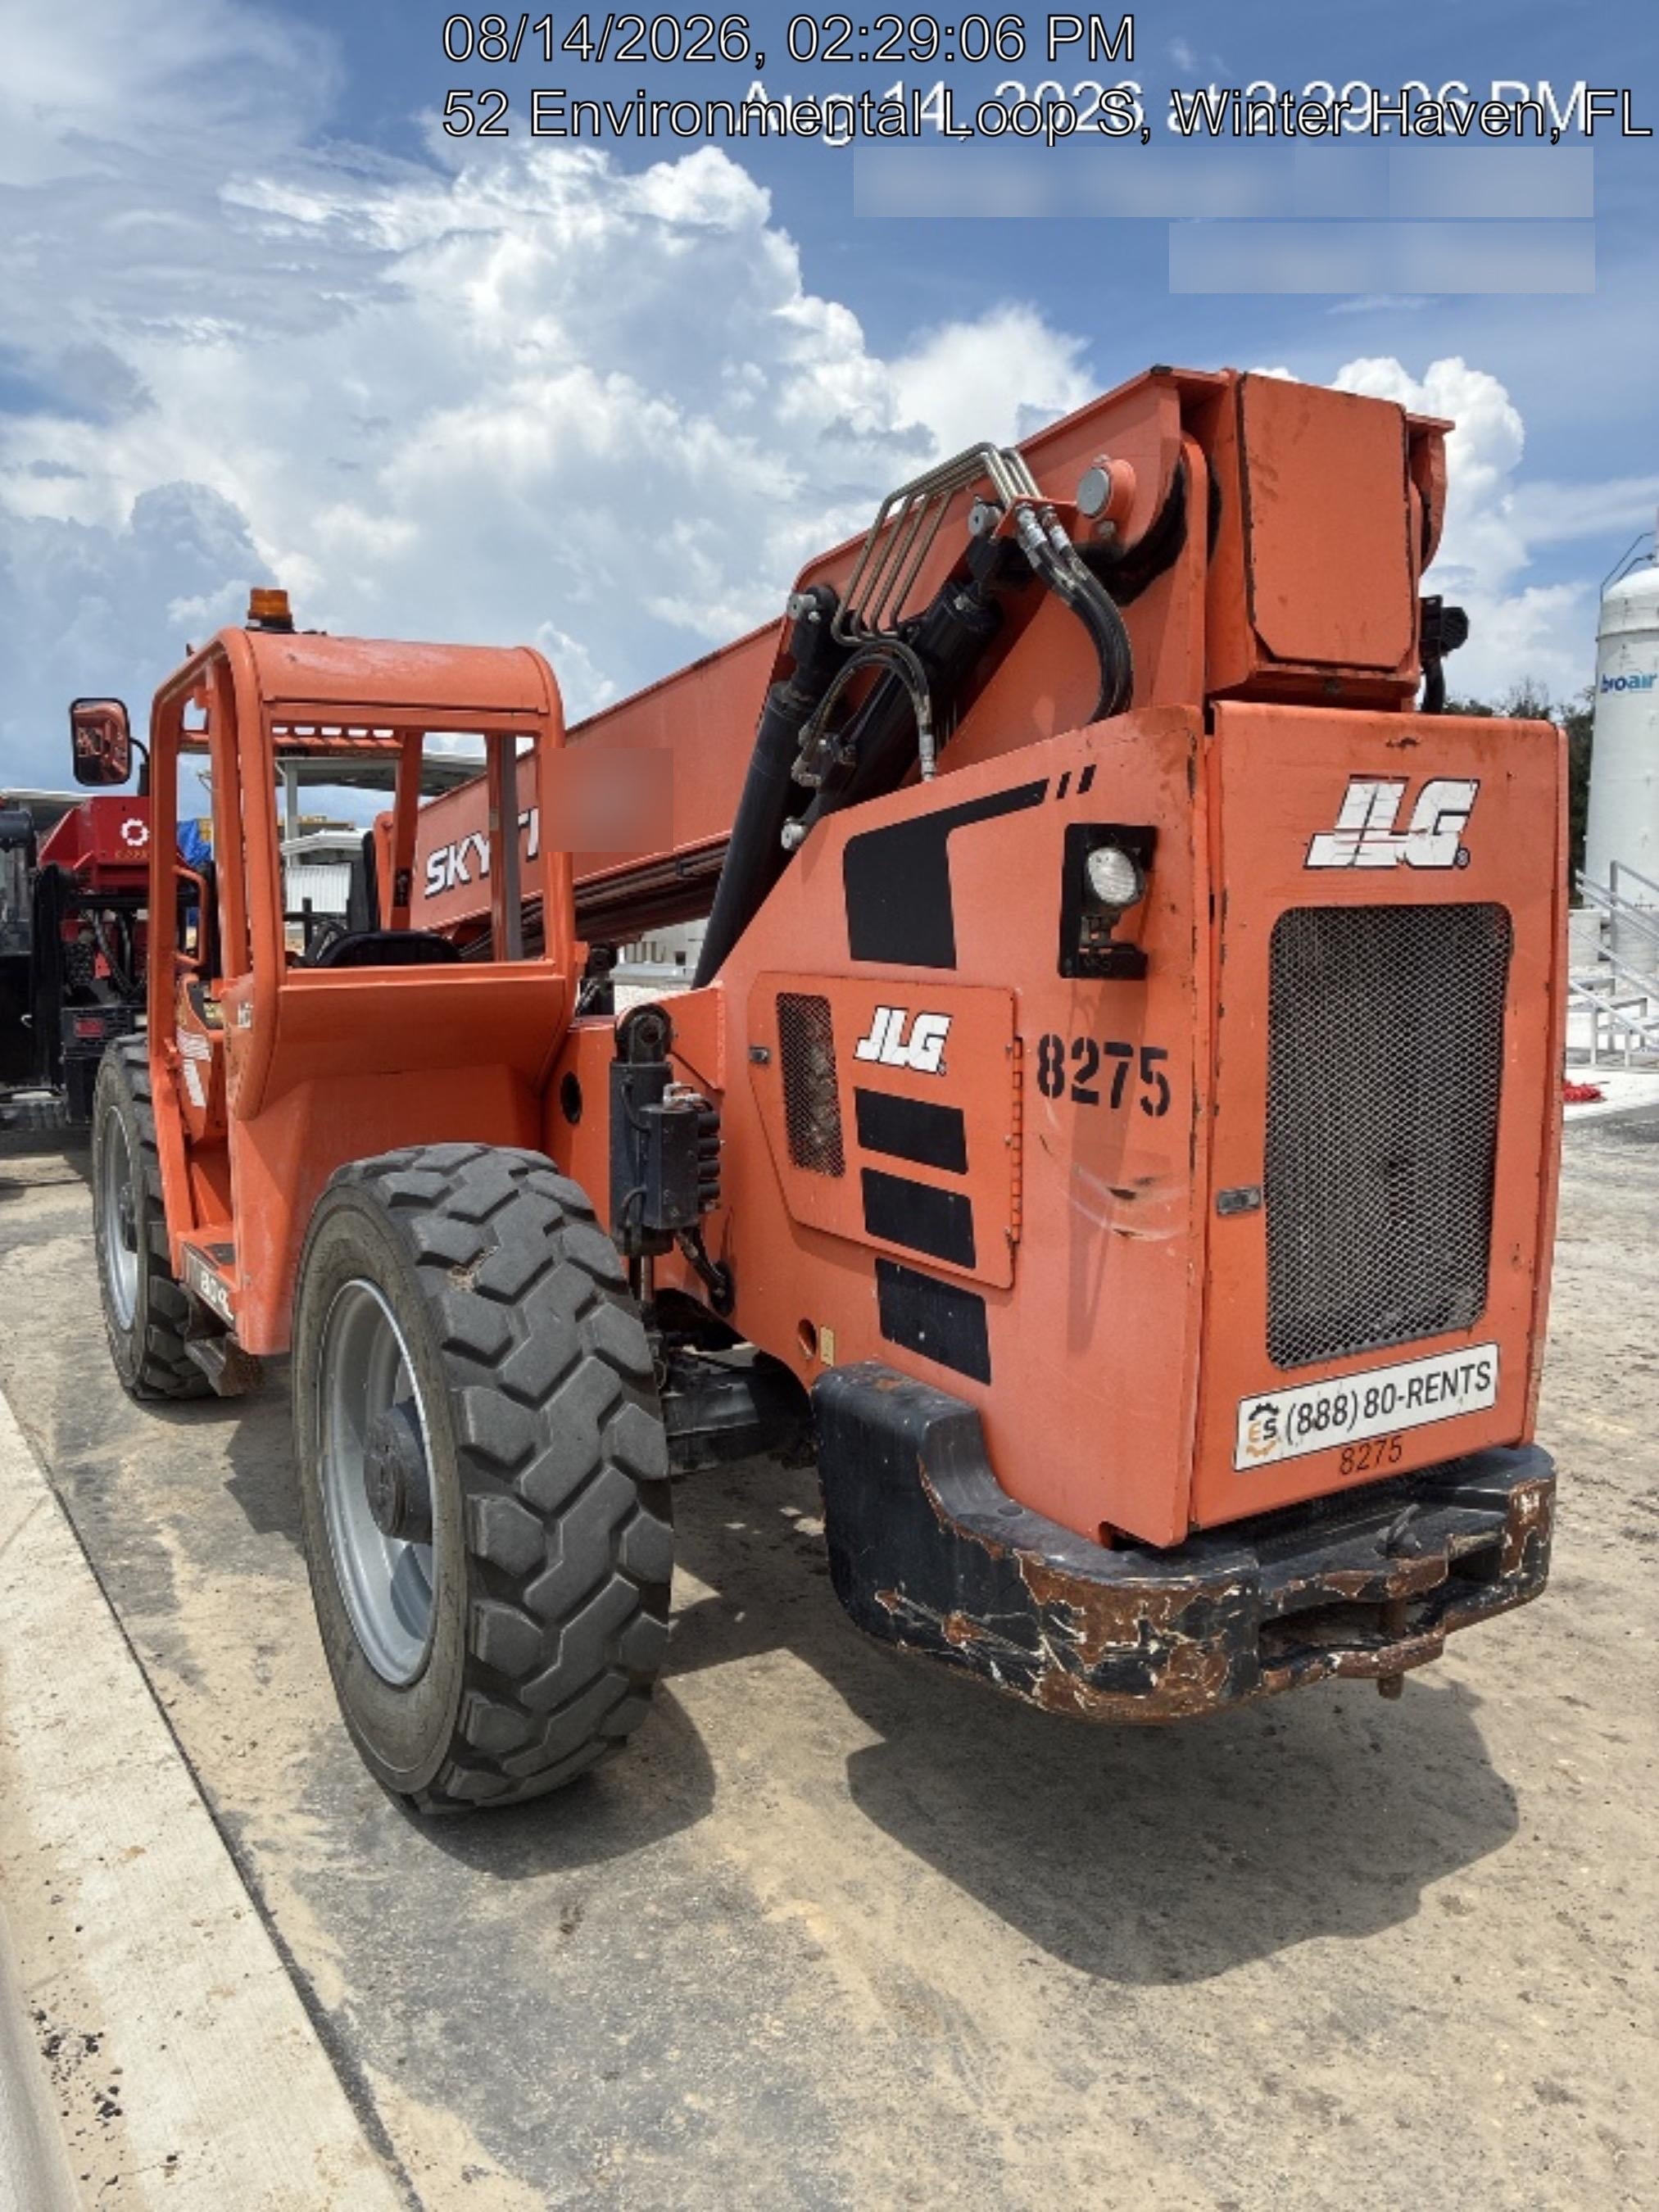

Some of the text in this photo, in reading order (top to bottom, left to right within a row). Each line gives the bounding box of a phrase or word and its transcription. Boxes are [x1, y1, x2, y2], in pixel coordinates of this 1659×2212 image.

[1303, 774, 1480, 869] JLG
[853, 1005, 954, 1075] JLG
[1037, 1033, 1171, 1117] 8275
[1285, 1390, 1359, 1445] (888)
[1364, 1361, 1491, 1419] 80-RENTS
[1339, 1435, 1403, 1475] 8275
